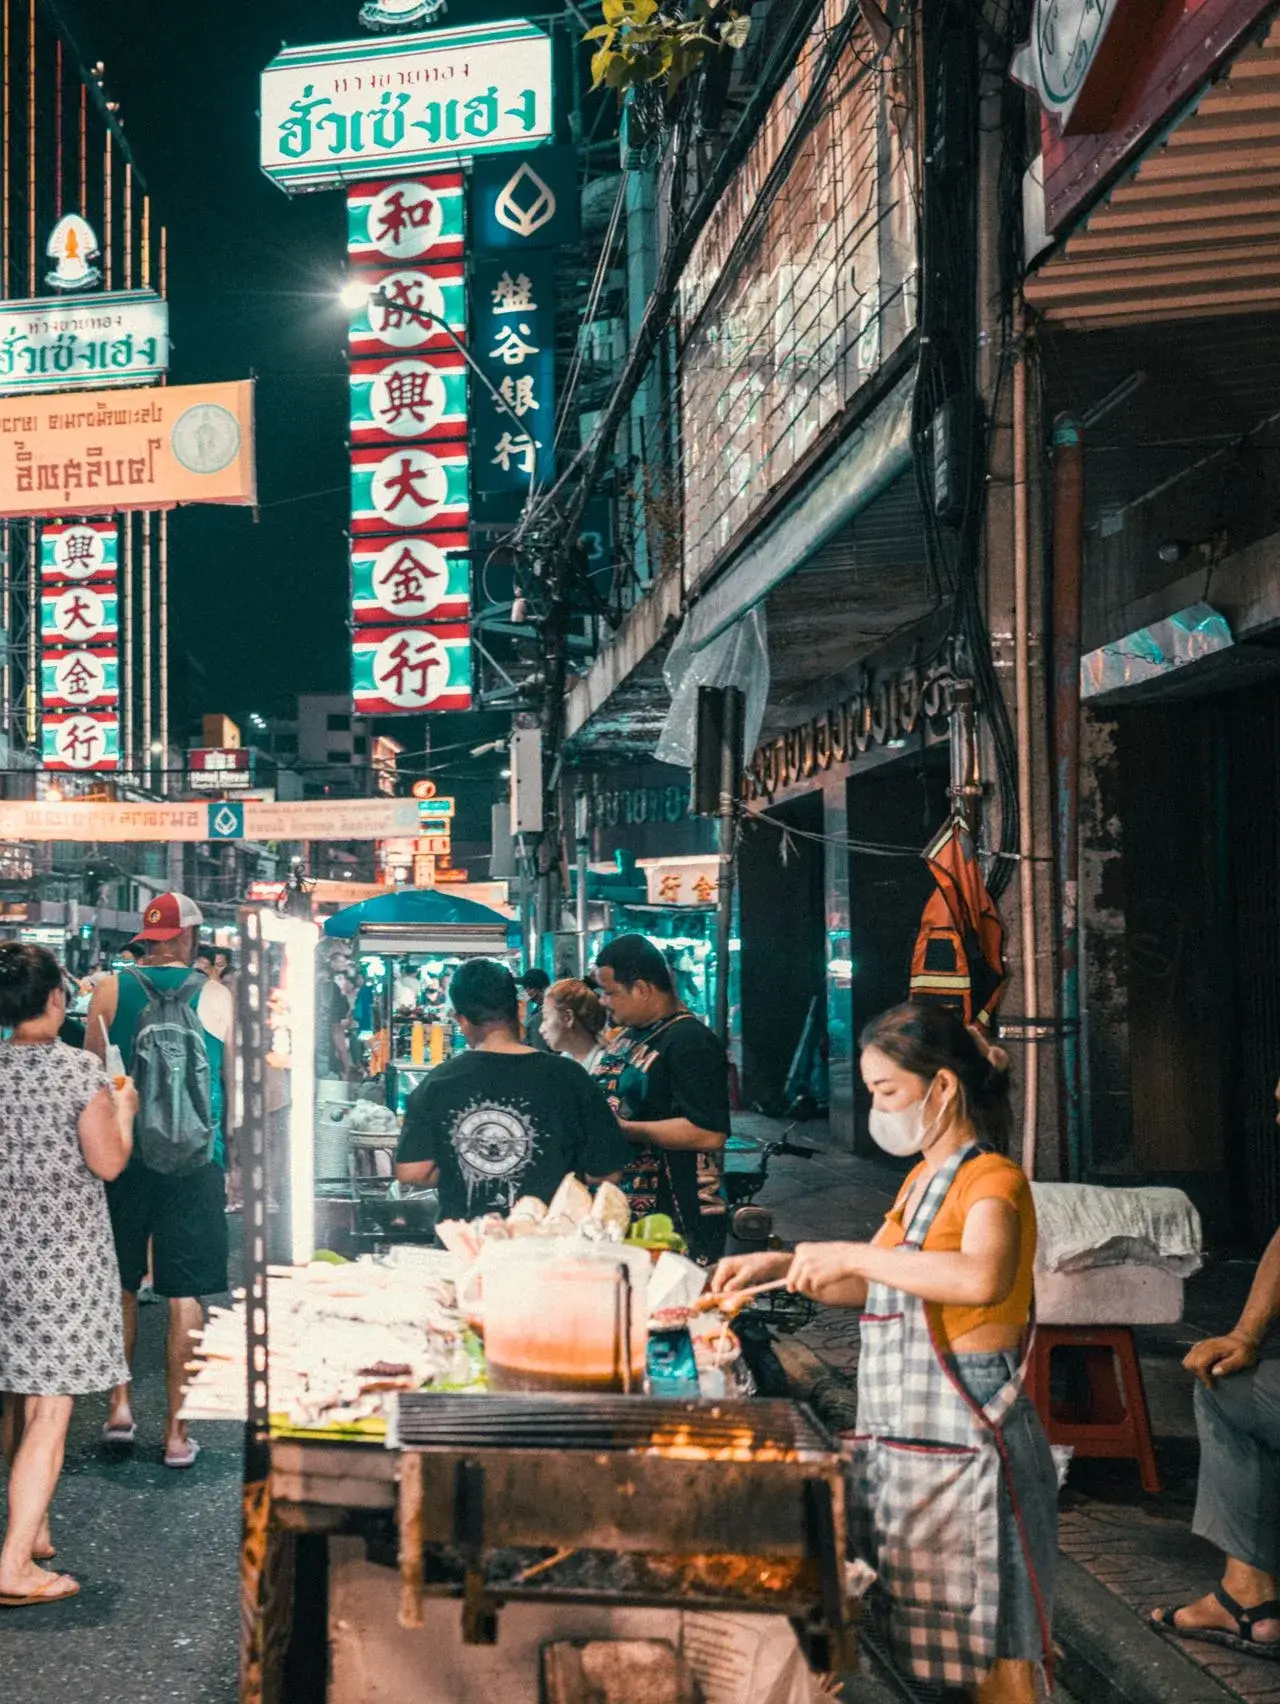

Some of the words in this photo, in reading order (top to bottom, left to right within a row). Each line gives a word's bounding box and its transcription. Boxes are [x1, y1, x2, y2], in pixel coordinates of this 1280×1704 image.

[278, 84, 537, 158] ฮั่วเซ่งเฮง
[376, 190, 441, 697] 和成興大金行
[61, 534, 100, 762] 興大金行
